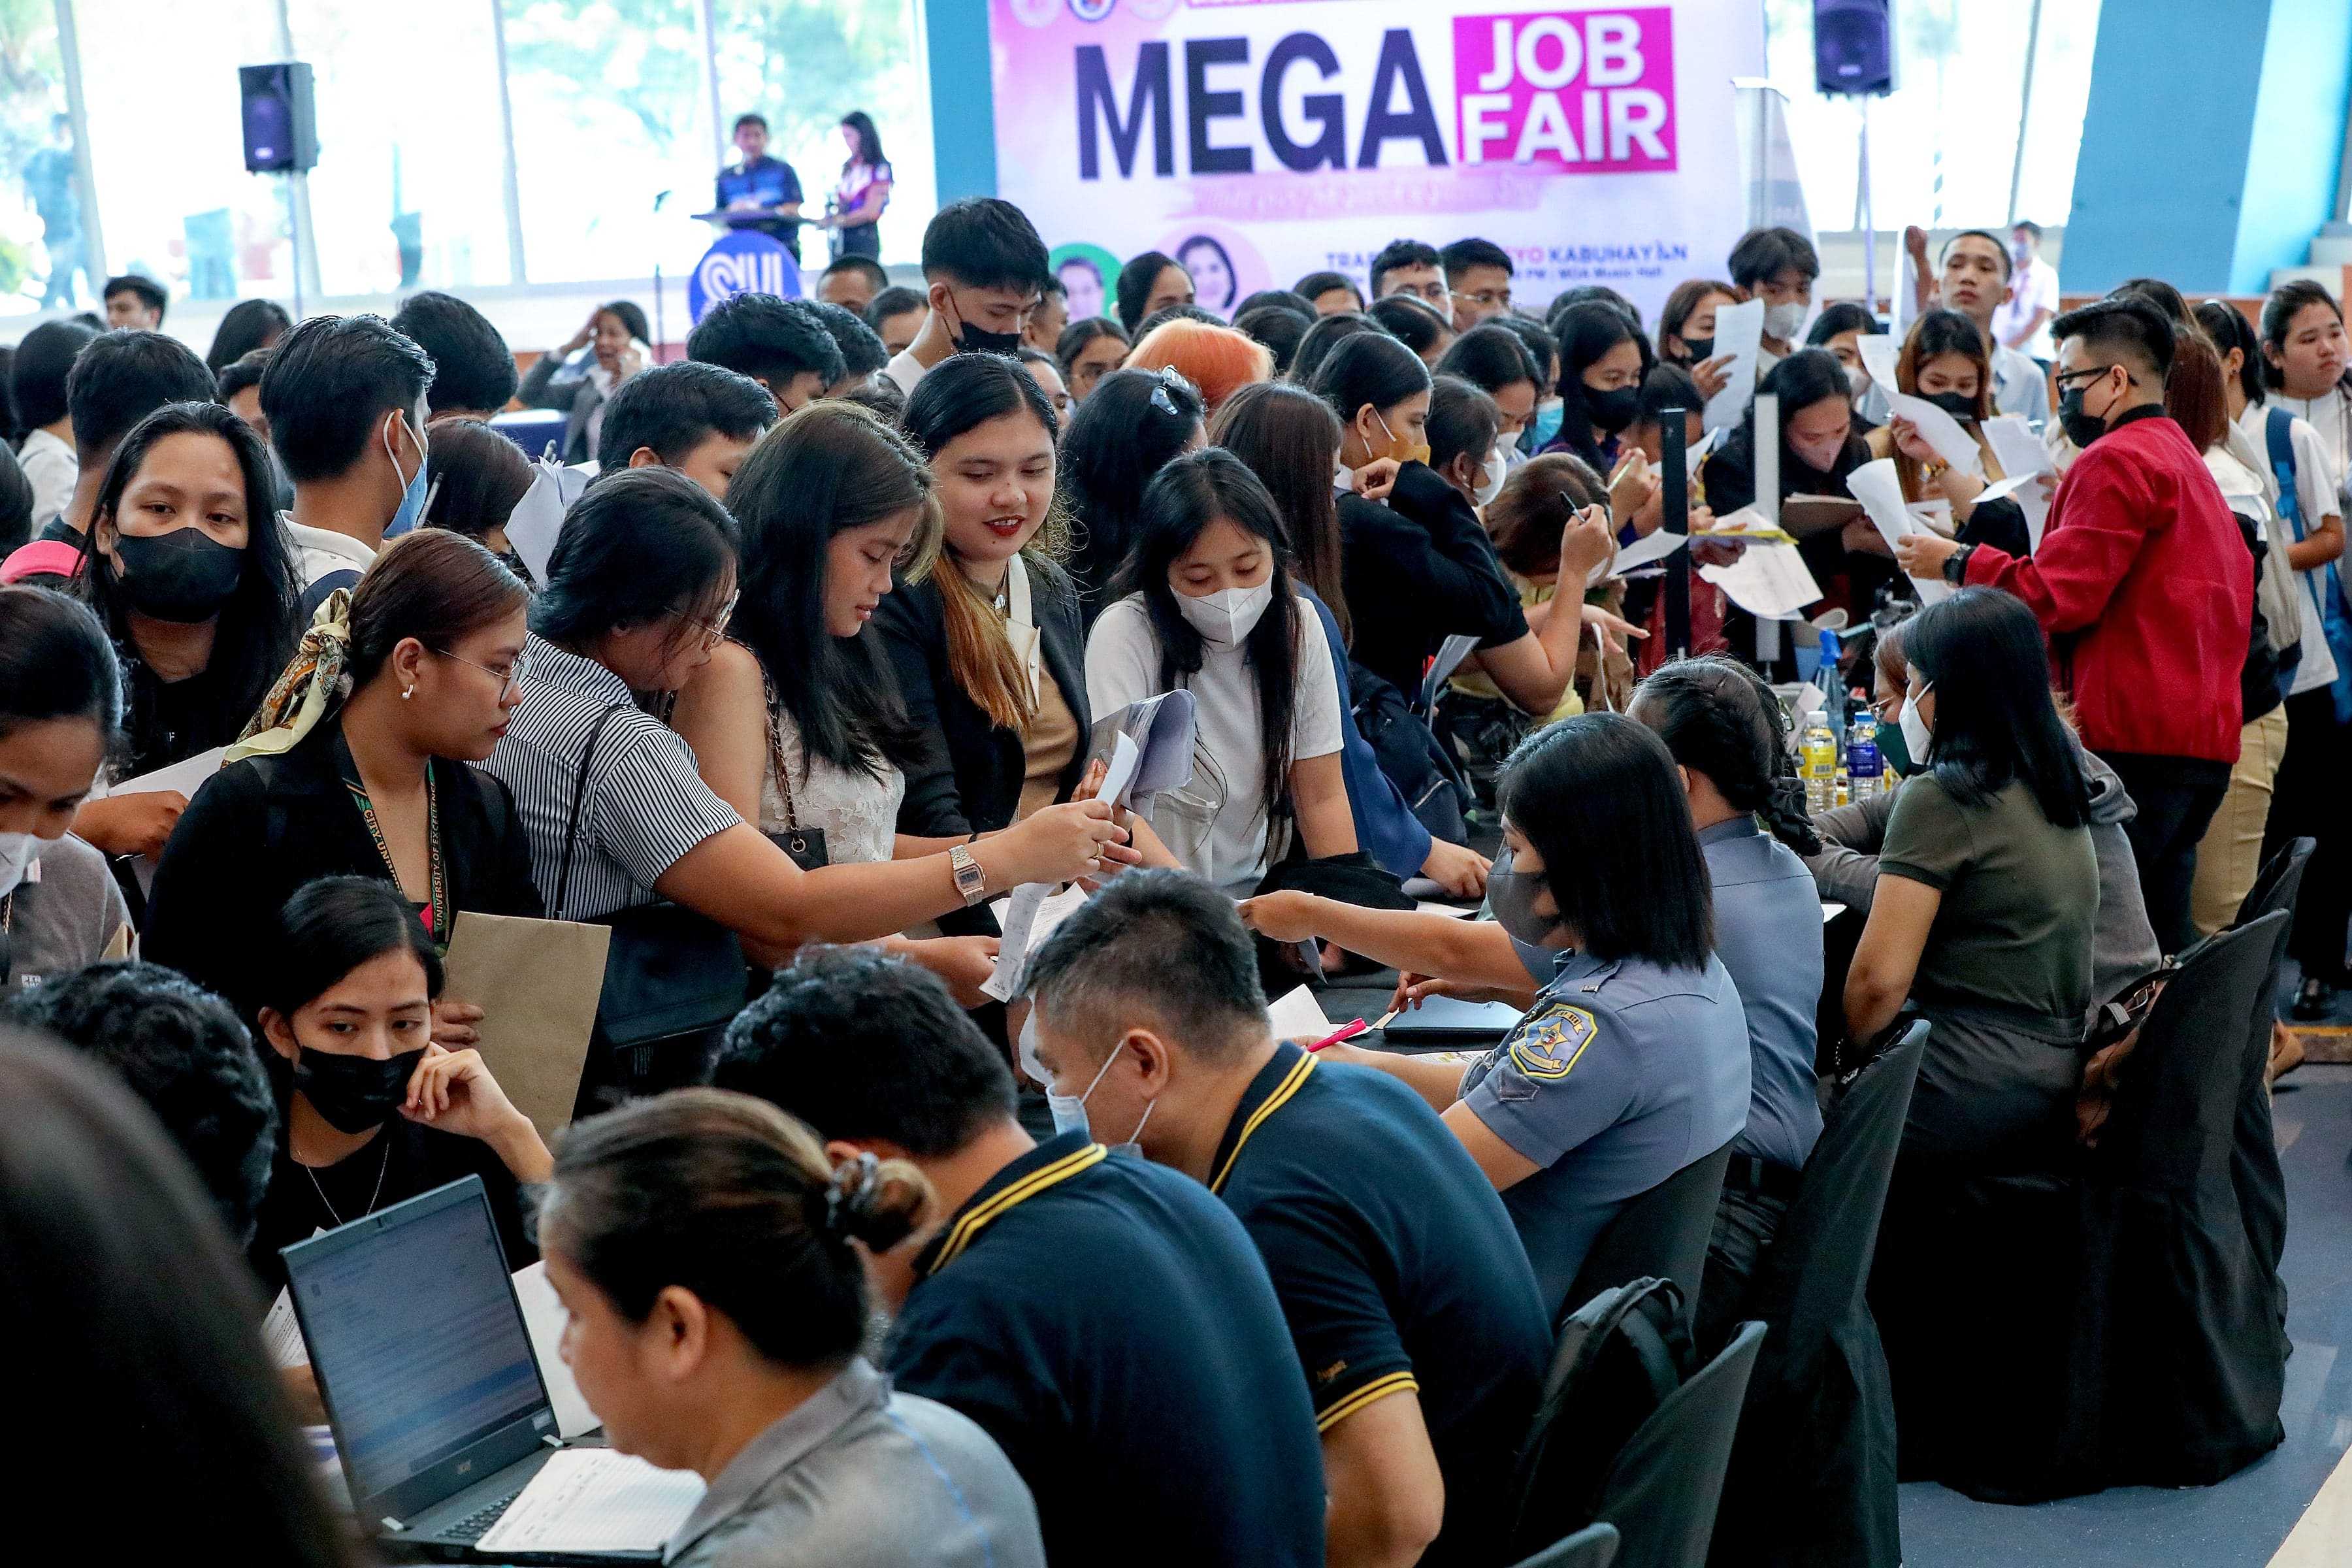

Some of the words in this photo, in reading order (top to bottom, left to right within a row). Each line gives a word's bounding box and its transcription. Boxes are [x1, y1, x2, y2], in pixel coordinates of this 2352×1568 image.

[1478, 14, 1644, 92] JOB
[1074, 28, 1450, 181] MEGA
[1462, 87, 1670, 166] FAIR
[363, 809, 384, 840] CITY
[433, 846, 440, 861] OF
[433, 862, 443, 926] UNIVERSITY
